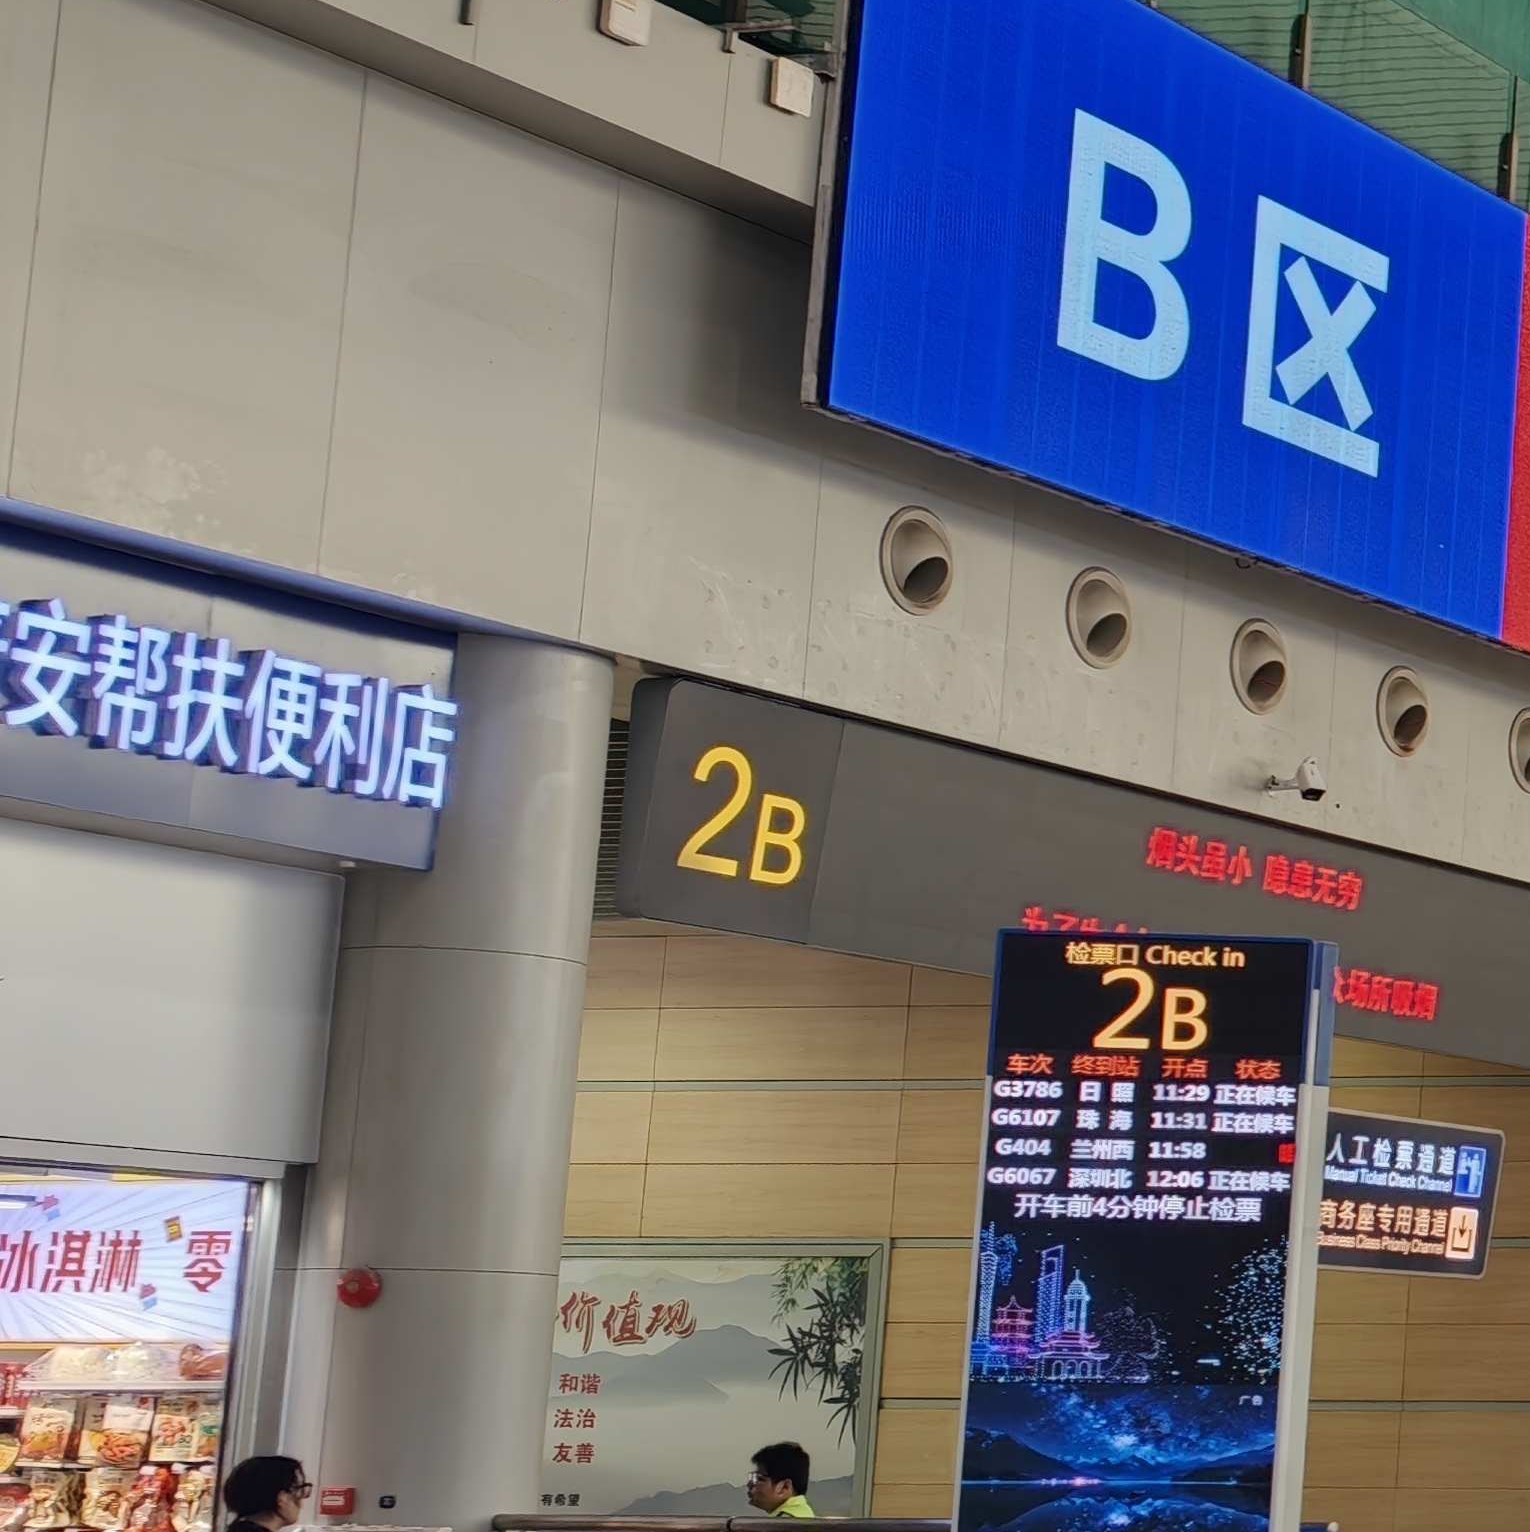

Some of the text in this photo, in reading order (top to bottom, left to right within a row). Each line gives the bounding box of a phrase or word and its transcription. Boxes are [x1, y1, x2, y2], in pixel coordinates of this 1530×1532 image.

[1057, 108, 1389, 478] B区
[0, 598, 461, 811] 安帮扶便利店
[676, 745, 807, 888] 2B
[1066, 941, 1246, 968] 检票口 Check in
[1092, 967, 1208, 1050] 2B
[1006, 1054, 1282, 1081] 车次 终到站 开点 状态
[993, 1080, 1063, 1099] G3786
[1152, 1084, 1210, 1103] 11:29
[1214, 1084, 1297, 1106] 正在候车
[991, 1109, 1062, 1128] G6107
[1150, 1112, 1208, 1130] 11:31
[1211, 1112, 1295, 1134] 正在候车
[995, 1138, 1207, 1161] G404 兰州西 11:58
[1325, 1132, 1457, 1176] 人工检票通道
[986, 1167, 1292, 1192] G6067 深圳北 12:06 正在候车
[1325, 1165, 1453, 1193] Manual Ticket Check Channel
[1014, 1193, 1262, 1222] 开车前4分钟停止检票
[182, 1229, 233, 1292] 零
[558, 1372, 602, 1395] 和谐
[552, 1408, 597, 1430] 法治
[551, 1442, 596, 1464] 友善
[540, 1492, 581, 1508] 有希望
